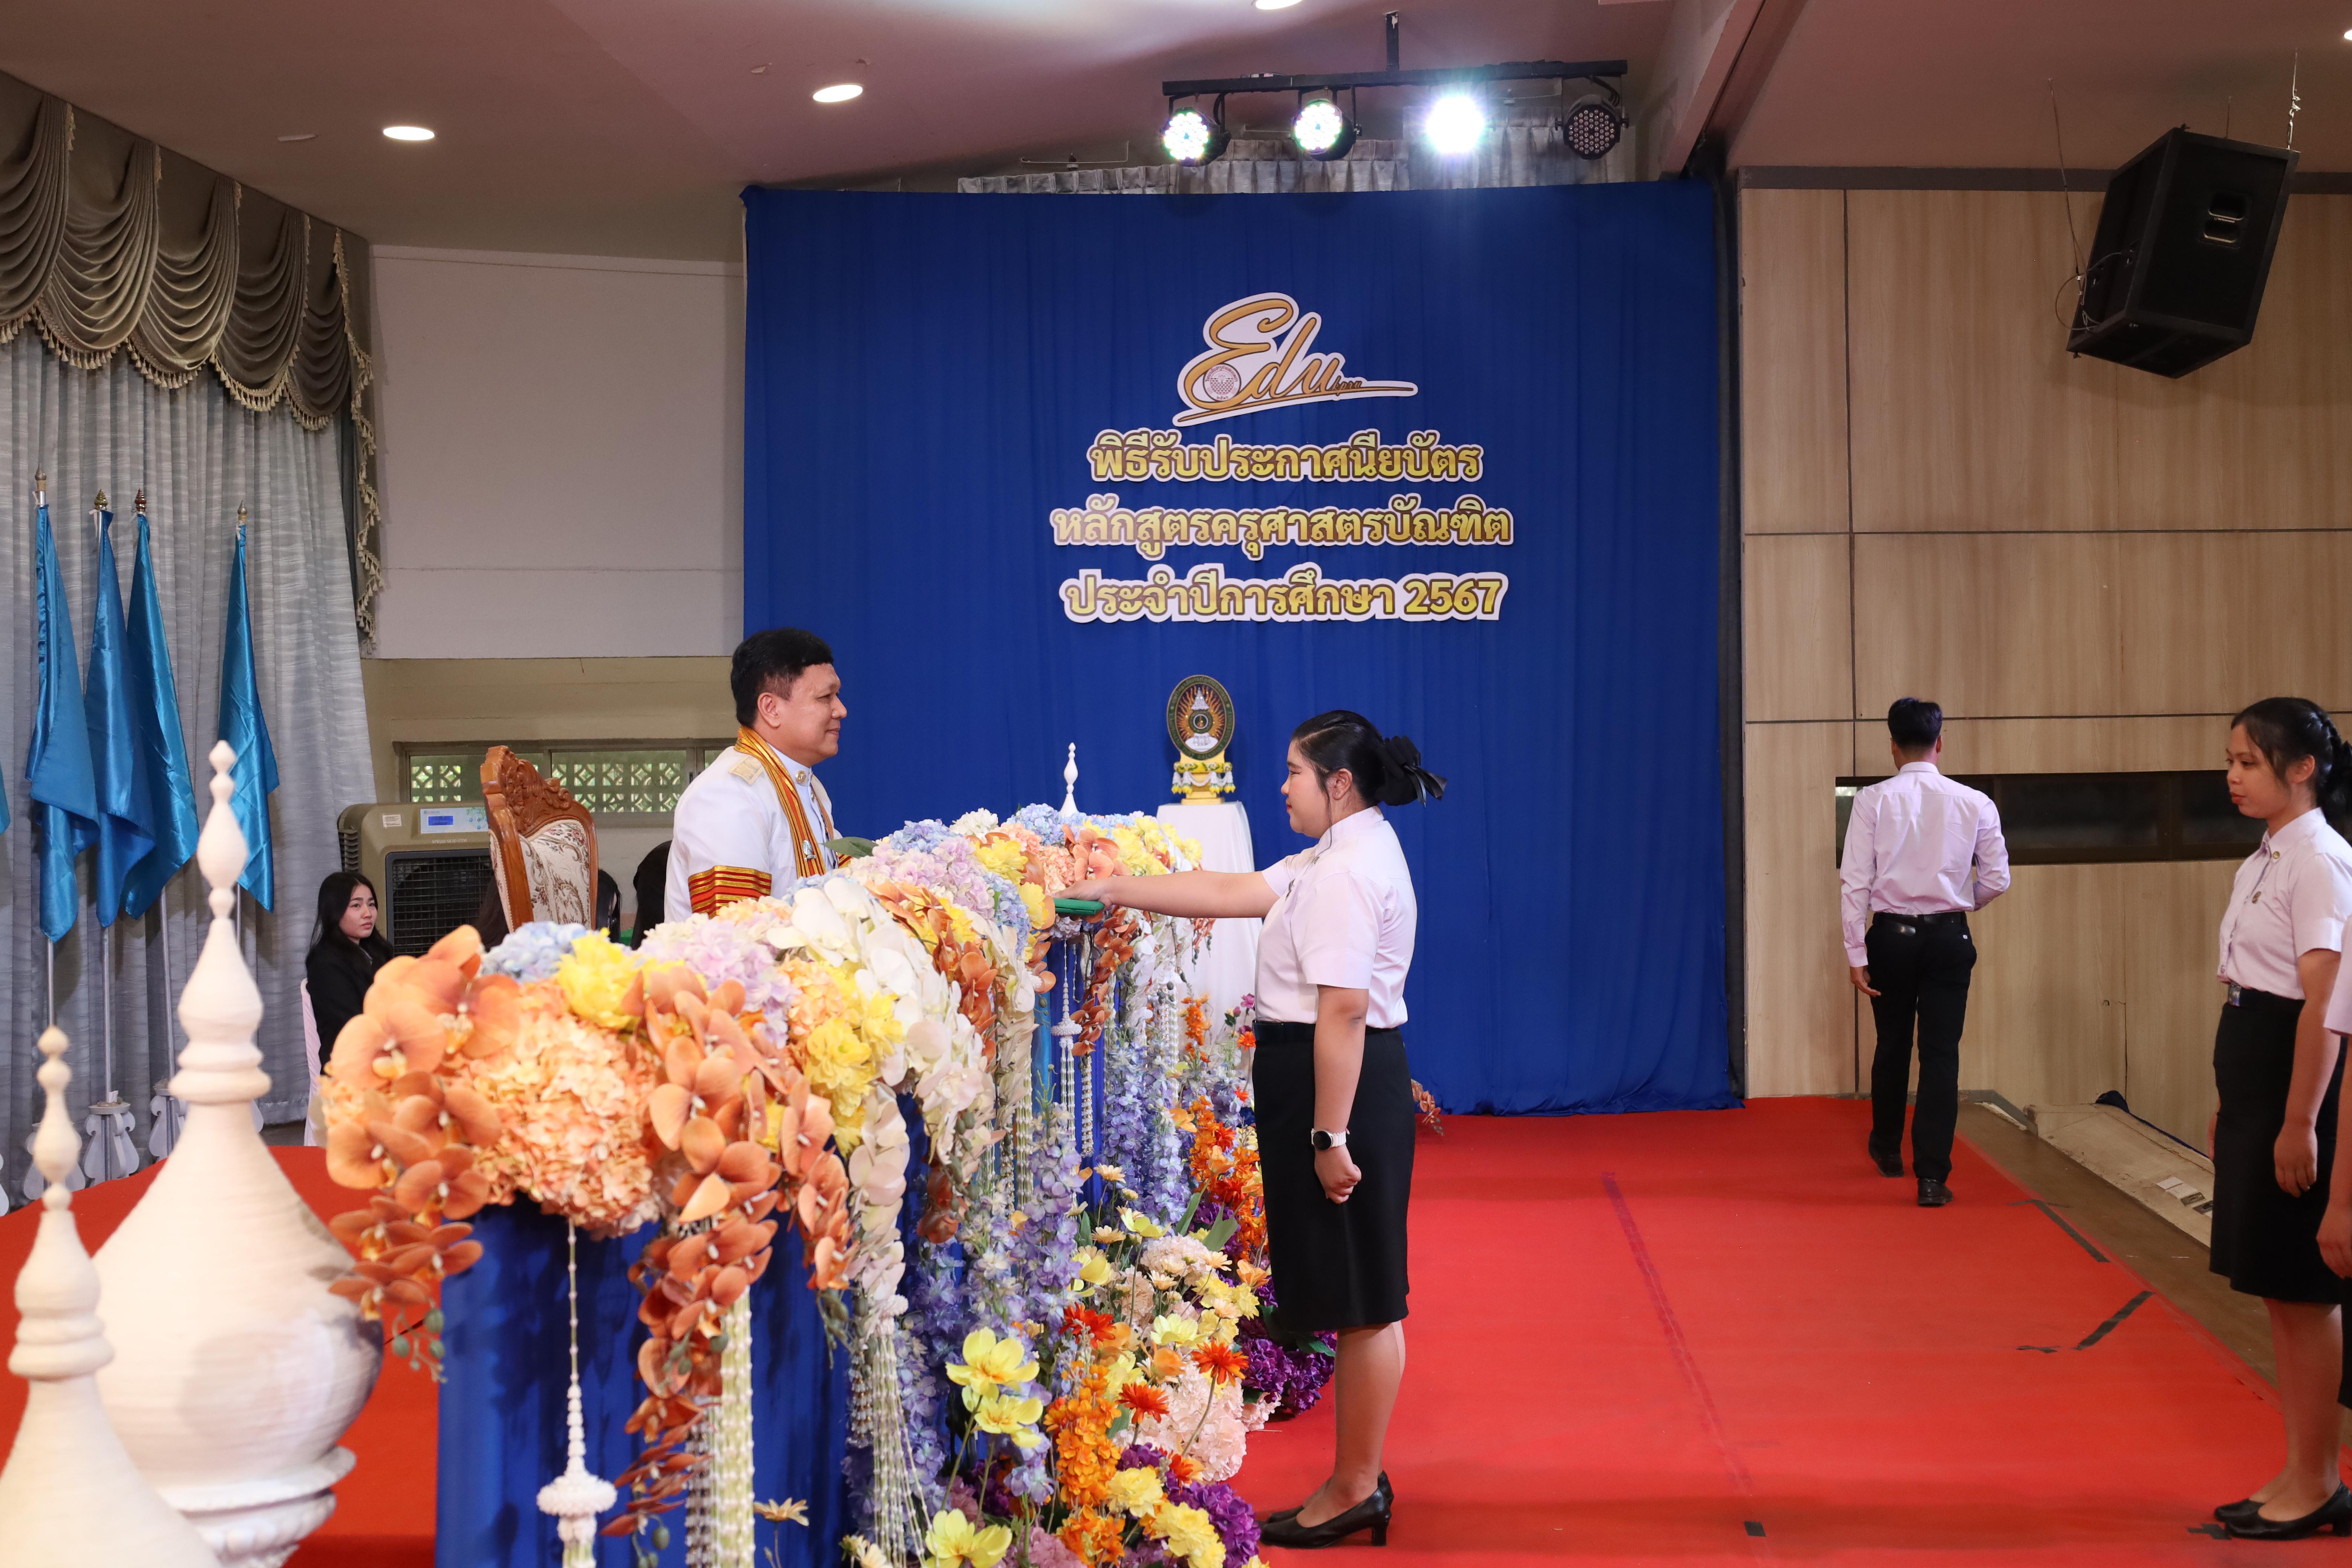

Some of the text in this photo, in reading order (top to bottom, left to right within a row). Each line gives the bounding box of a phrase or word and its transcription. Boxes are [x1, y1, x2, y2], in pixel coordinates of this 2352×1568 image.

[1184, 298, 1339, 410] Edu
[1090, 431, 1481, 478] พิธีรับประกาศนียบัตร
[1053, 496, 1511, 559] หลักสูตรครุศาสตรบัณฑิต
[1065, 568, 1503, 616] ประจำปีการศึกษา 2567
